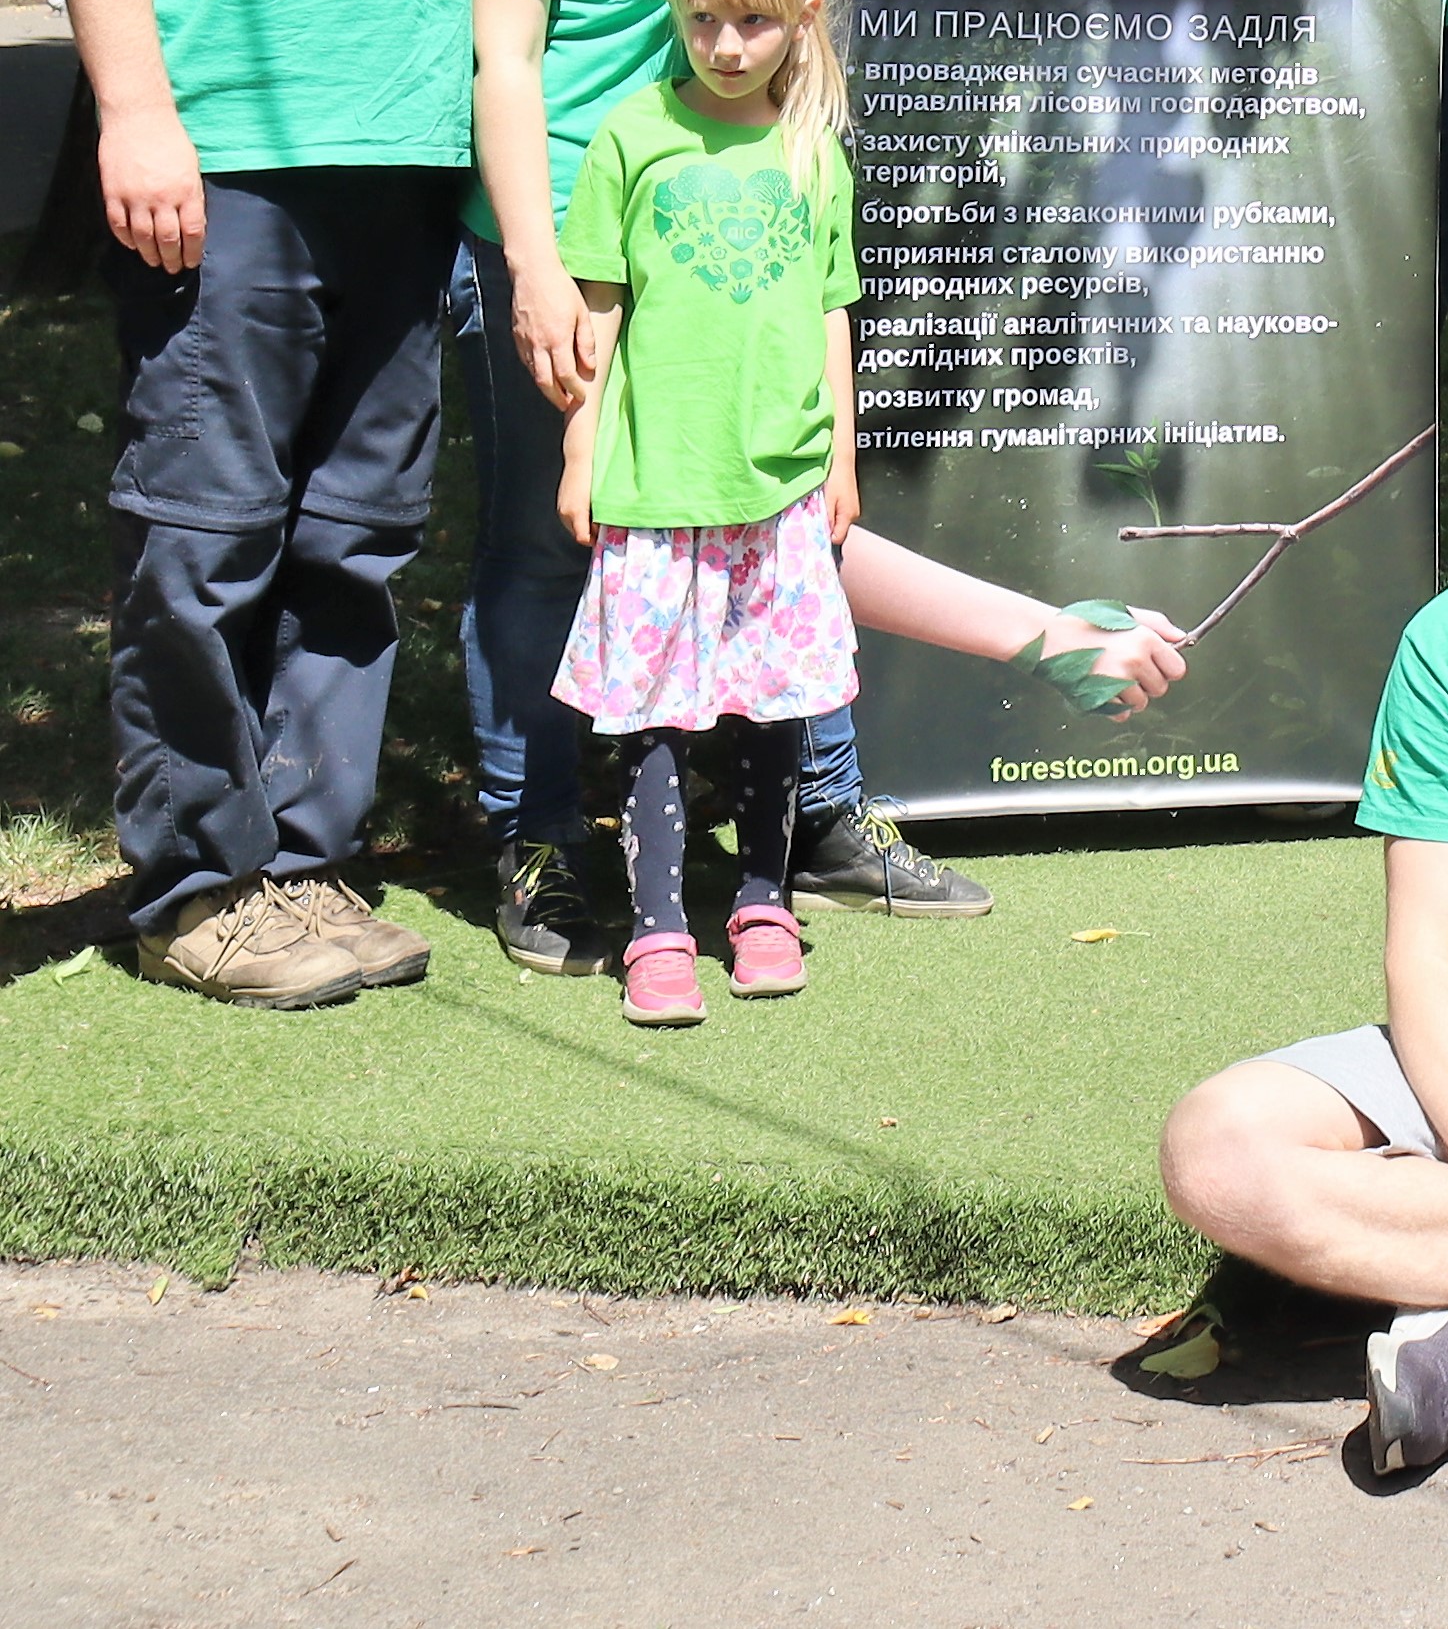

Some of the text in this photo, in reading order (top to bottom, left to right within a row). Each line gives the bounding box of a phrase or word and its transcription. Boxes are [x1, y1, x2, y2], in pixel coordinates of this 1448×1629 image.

[859, 9, 1317, 49] МИ ПРАЦЮЄМО ЗАДЛЯ
[864, 62, 1318, 90] впровадження сучасних методів
[863, 90, 1366, 119] управління лісовим господарством,
[862, 130, 1290, 159] захисту унікальних природних
[862, 160, 1007, 188] територій,
[861, 200, 1336, 229] боротьби з незаконними рубками,
[725, 227, 757, 240] ЛІС
[860, 245, 1325, 269] сприяння сталому використанню
[862, 272, 1150, 300] природних ресурсів,
[859, 311, 1338, 340] реалізації аналітичних та науково-
[857, 342, 1137, 372] дослідних проєктів,
[857, 387, 1100, 414] розвитку громад,
[856, 420, 1286, 452] втілення гуманітарних ініціатив.
[990, 751, 1240, 783] forestcom.org.ua
